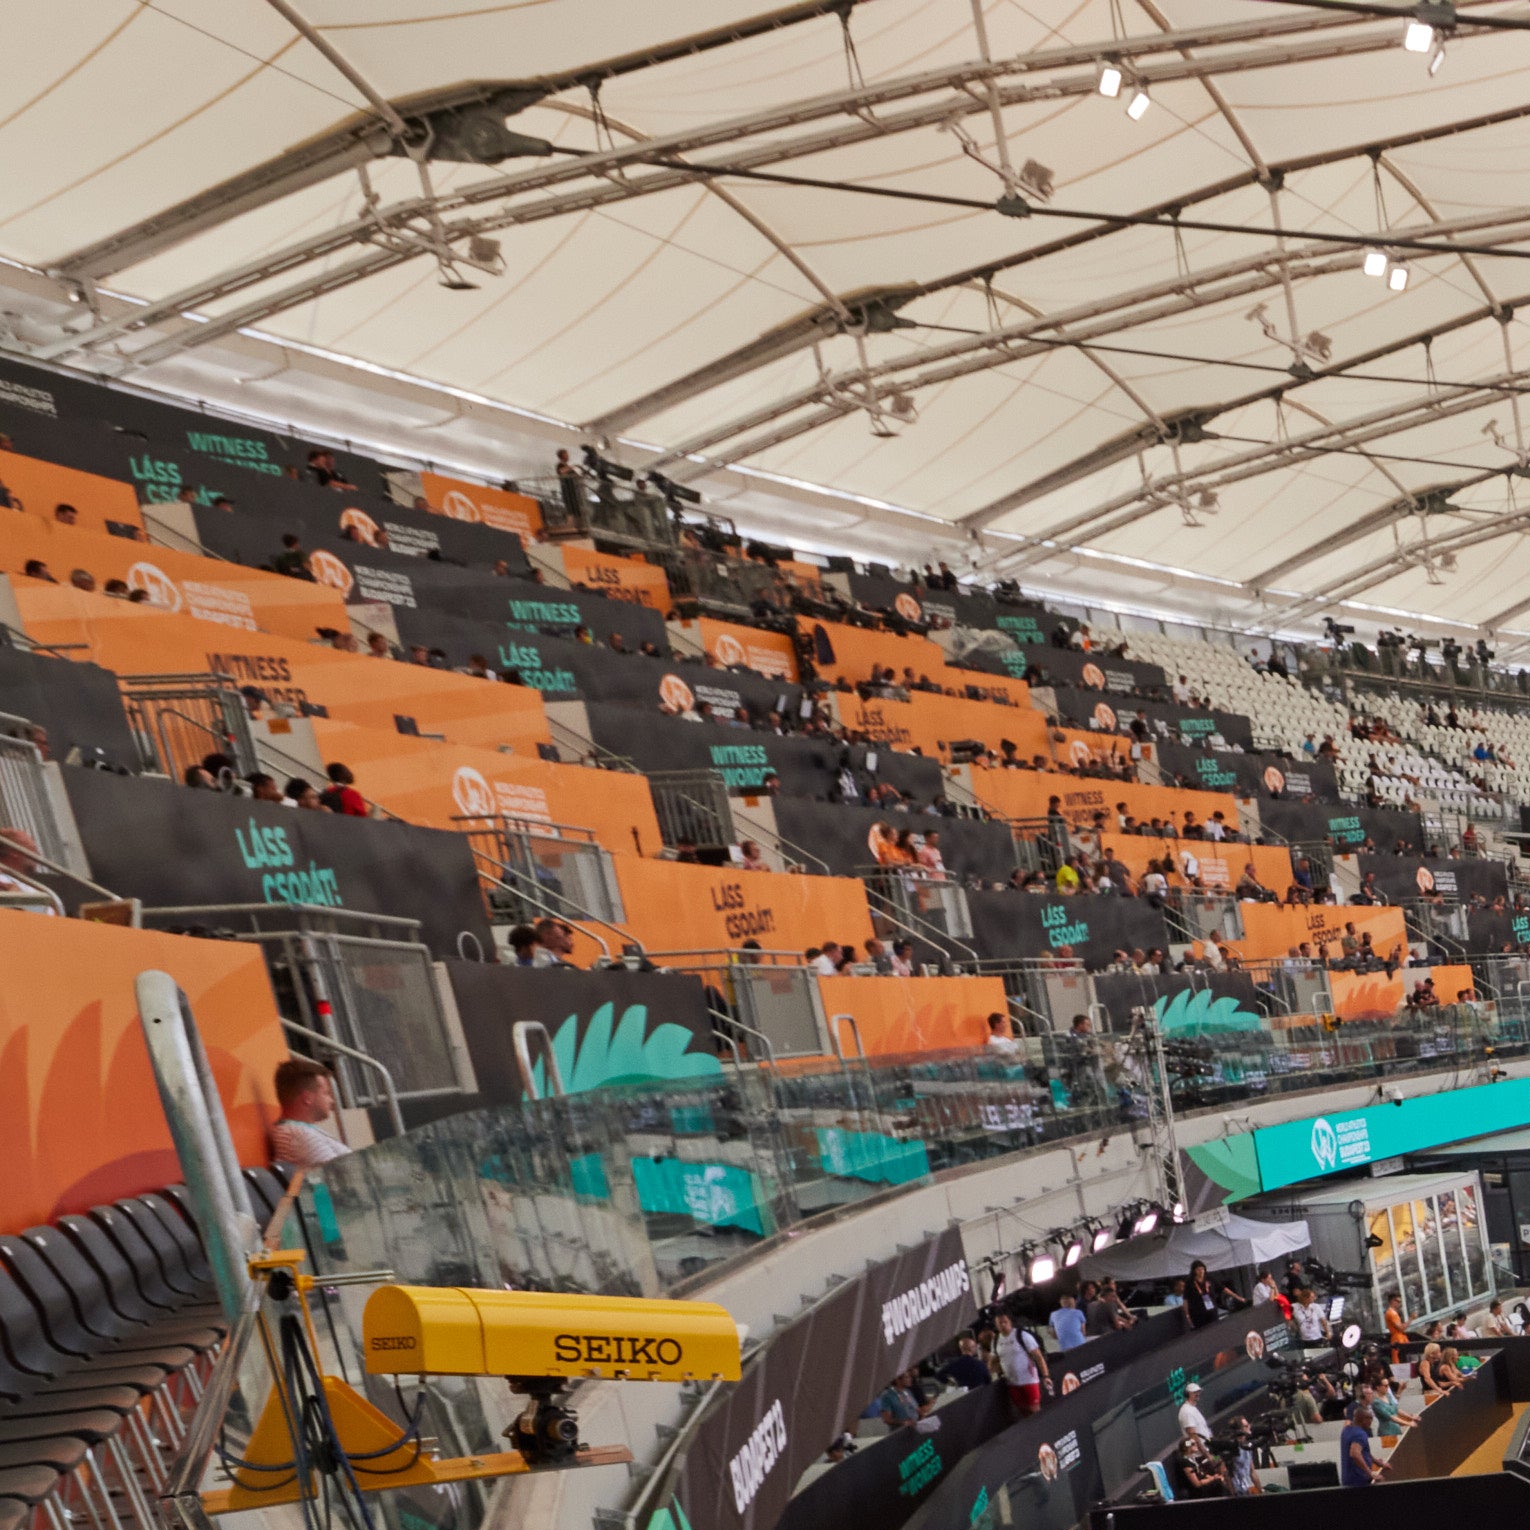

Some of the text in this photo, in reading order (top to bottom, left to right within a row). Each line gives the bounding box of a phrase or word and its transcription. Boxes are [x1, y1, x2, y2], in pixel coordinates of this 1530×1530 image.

[187, 431, 268, 461] WITNESS
[508, 600, 582, 624] WITNESS
[499, 642, 542, 669] LÁSS
[709, 745, 768, 765] WITNESS
[235, 816, 294, 869] LÁSS
[711, 882, 745, 912] LÁSS
[725, 906, 774, 940] CSODÁT!
[1041, 902, 1067, 928] LÁSS
[1049, 921, 1092, 948] CSODÁT!
[881, 1259, 970, 1346] #WORLDCHAMPS
[371, 1336, 417, 1351] SEIKO
[555, 1334, 683, 1365] SEIKO
